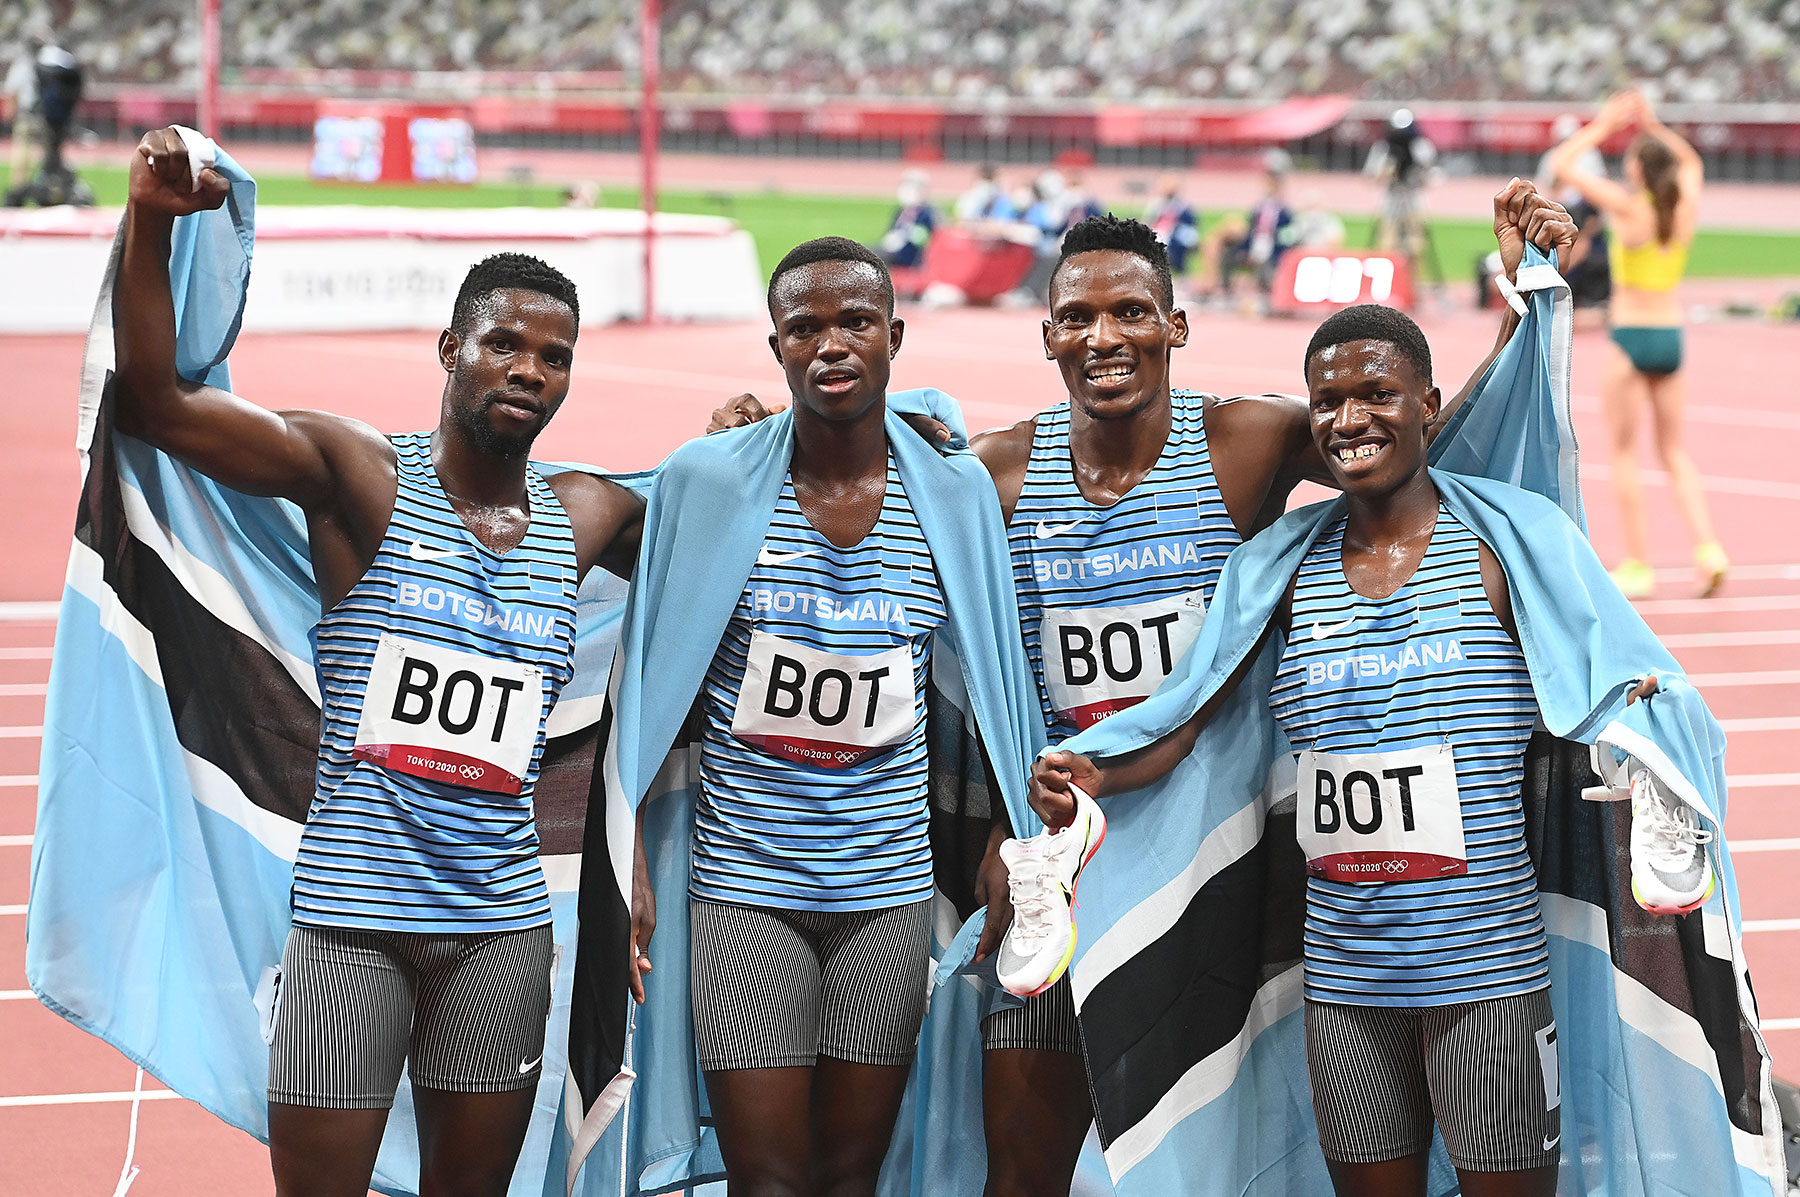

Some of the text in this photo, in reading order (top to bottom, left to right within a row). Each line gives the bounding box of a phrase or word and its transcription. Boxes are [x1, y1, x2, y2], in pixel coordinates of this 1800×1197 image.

[1036, 542, 1198, 582] BOTSWANA
[399, 582, 555, 638] BOTSWANA
[1059, 612, 1179, 685] BOT
[1309, 640, 1463, 685] BOTSWANA
[391, 656, 524, 742] BOT
[764, 654, 889, 727] BOT
[407, 755, 456, 773] TOKYO 2020
[783, 744, 832, 760] TOKYO 2020
[1315, 765, 1423, 834] BOT
[1337, 863, 1381, 872] TOKYO 2020
